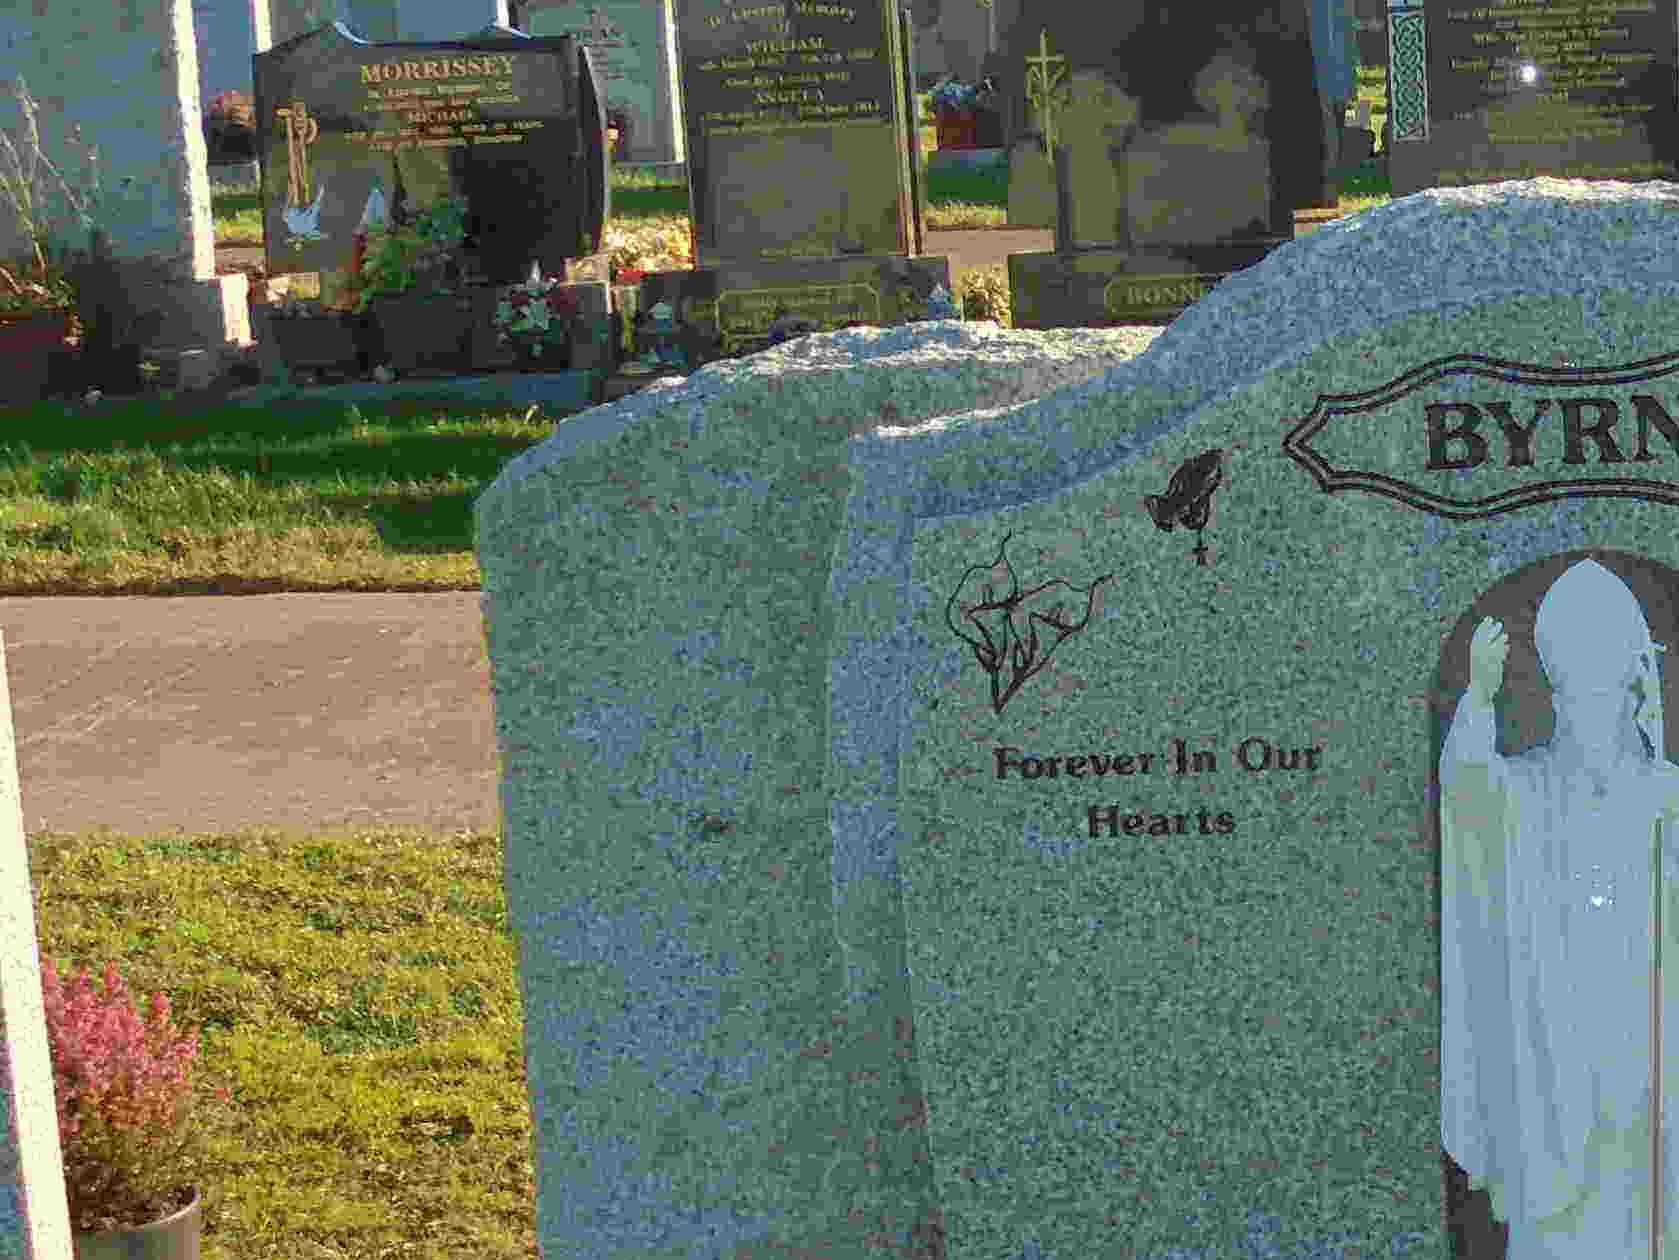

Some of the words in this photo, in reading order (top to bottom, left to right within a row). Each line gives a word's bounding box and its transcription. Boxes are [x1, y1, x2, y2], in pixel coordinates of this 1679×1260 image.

[360, 54, 517, 84] MORRISSEY
[1127, 280, 1210, 305] BONN
[992, 745, 1152, 779] Forever
[1173, 738, 1216, 776] In
[1240, 736, 1320, 772] Our
[1088, 805, 1234, 837] Hearts
